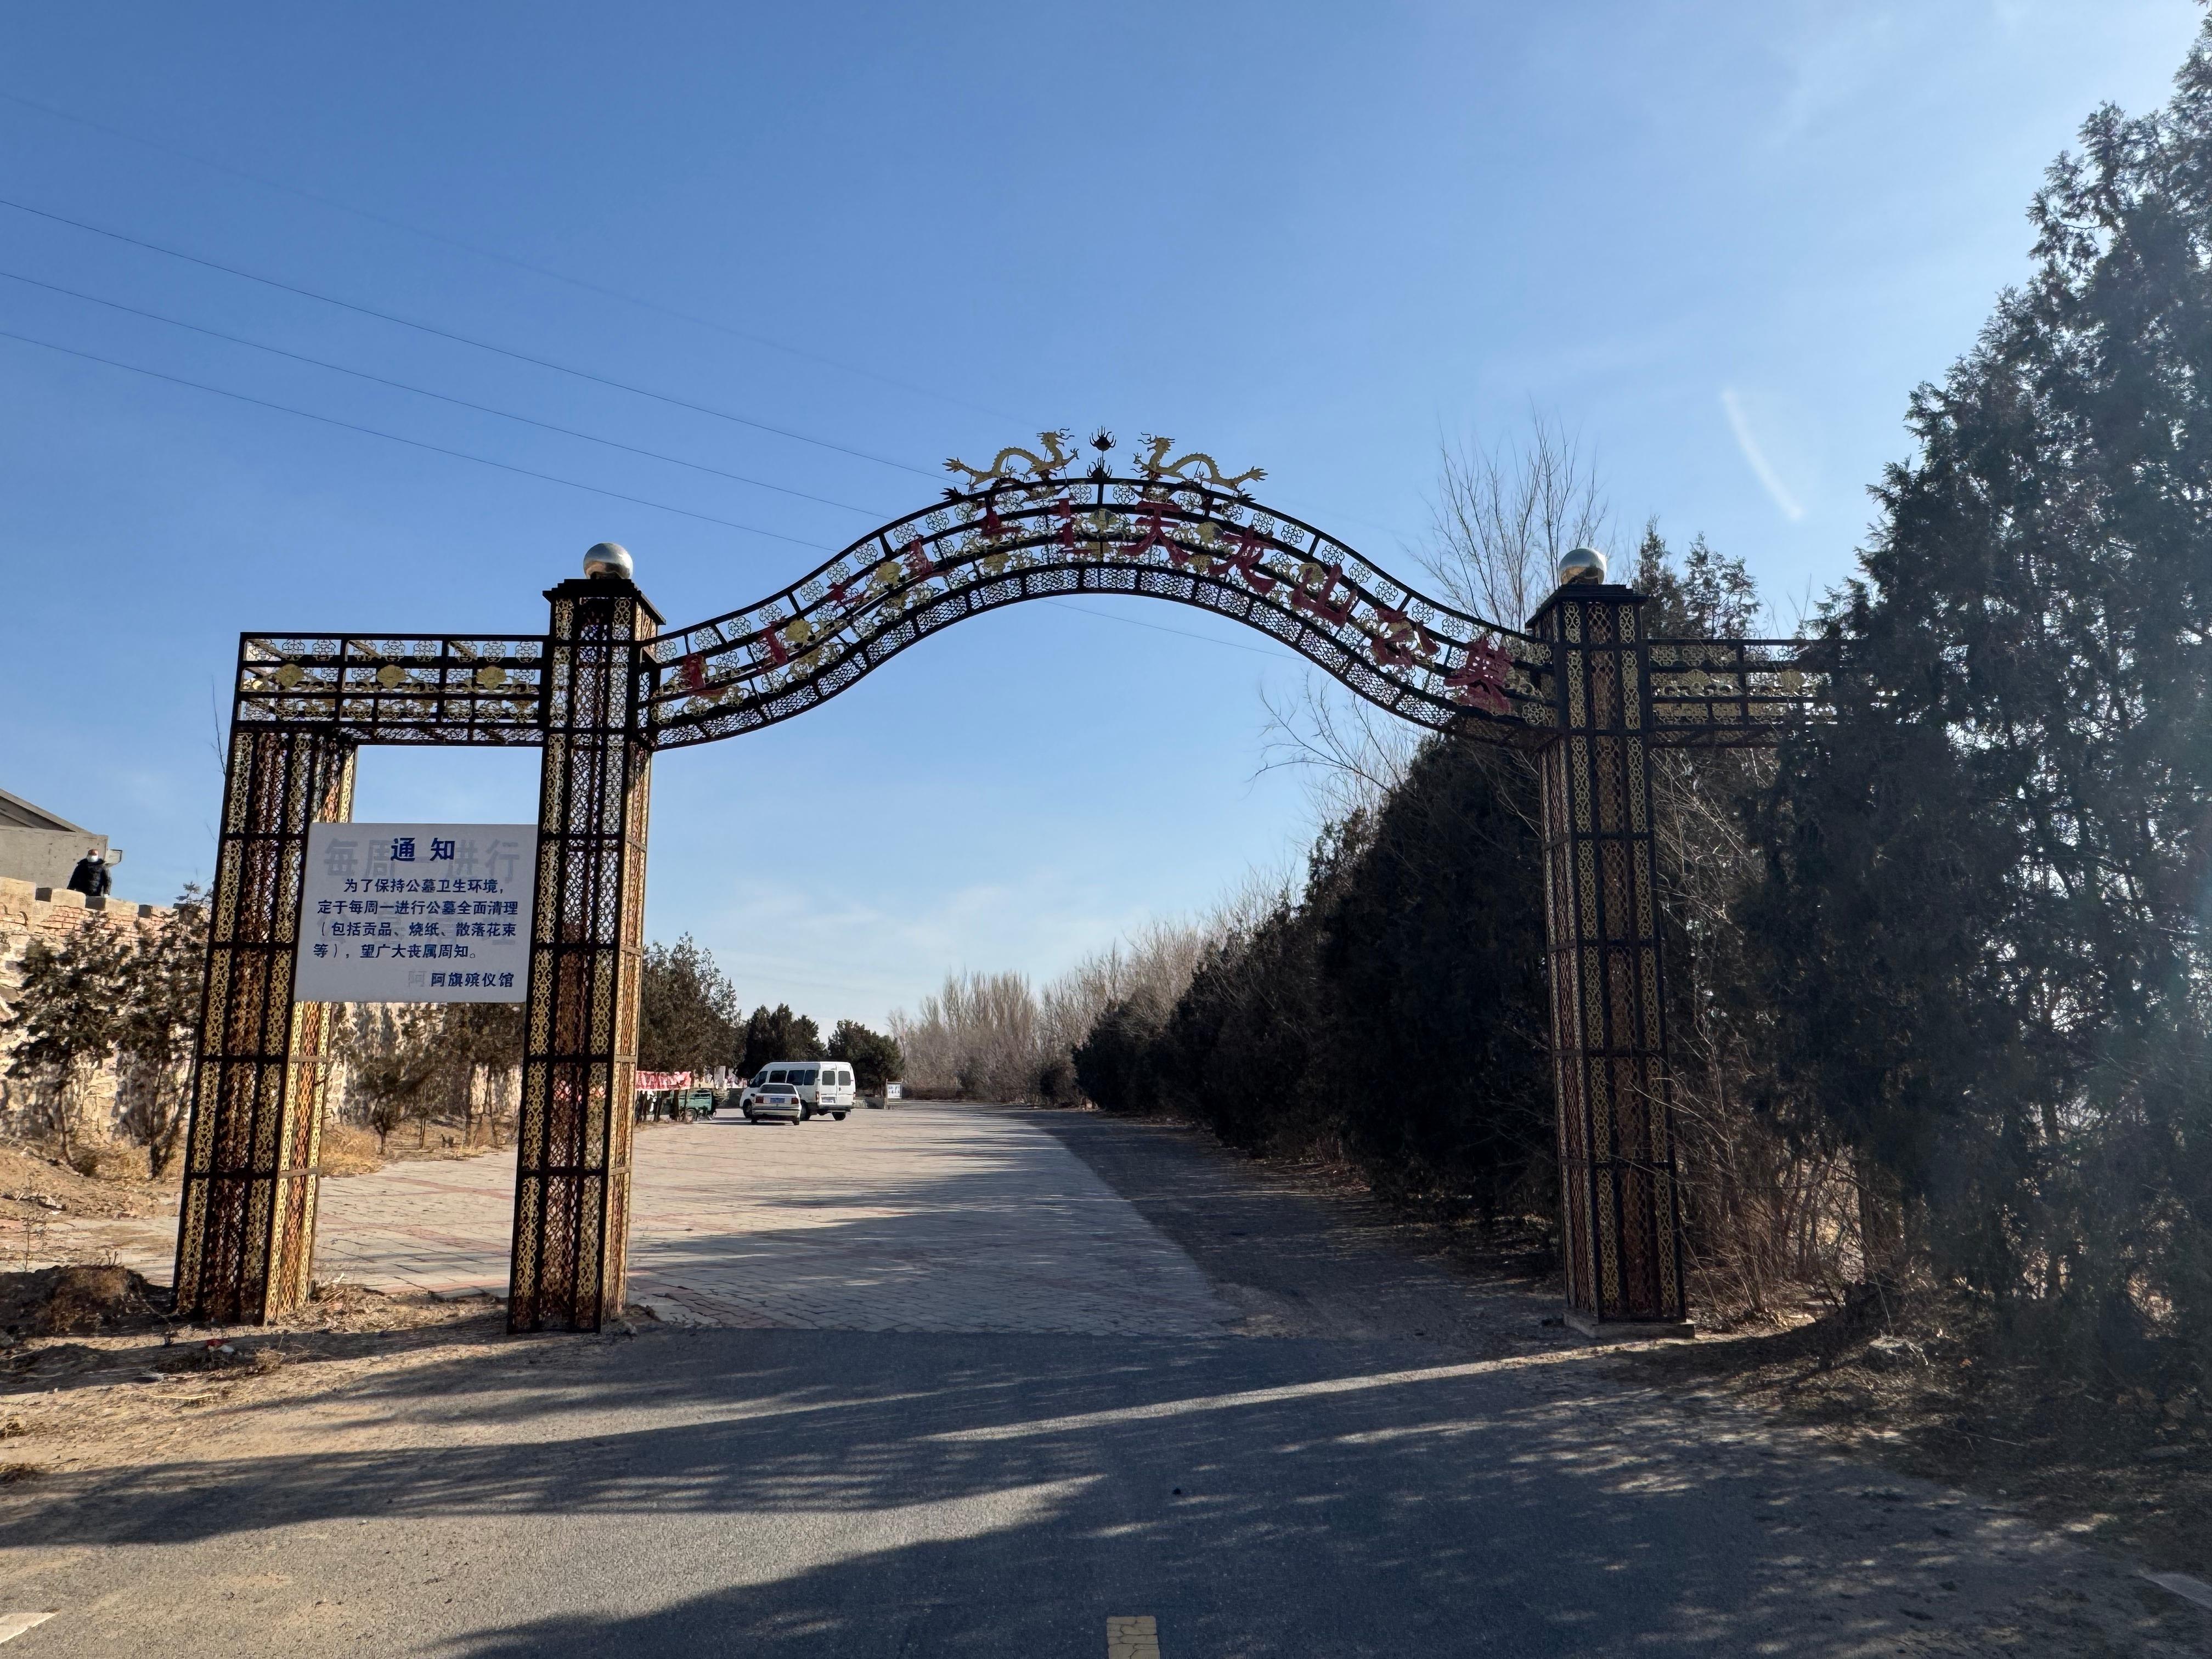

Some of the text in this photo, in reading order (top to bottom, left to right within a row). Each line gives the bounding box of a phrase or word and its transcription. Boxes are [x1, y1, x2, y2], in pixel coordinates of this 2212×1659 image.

[390, 837, 455, 861] 通知
[343, 878, 504, 894] 为了保持公墓卫生环境，
[317, 900, 518, 916] 定于每周一进行公墓全面清理
[430, 972, 515, 988] 阿旗殡仪馆
